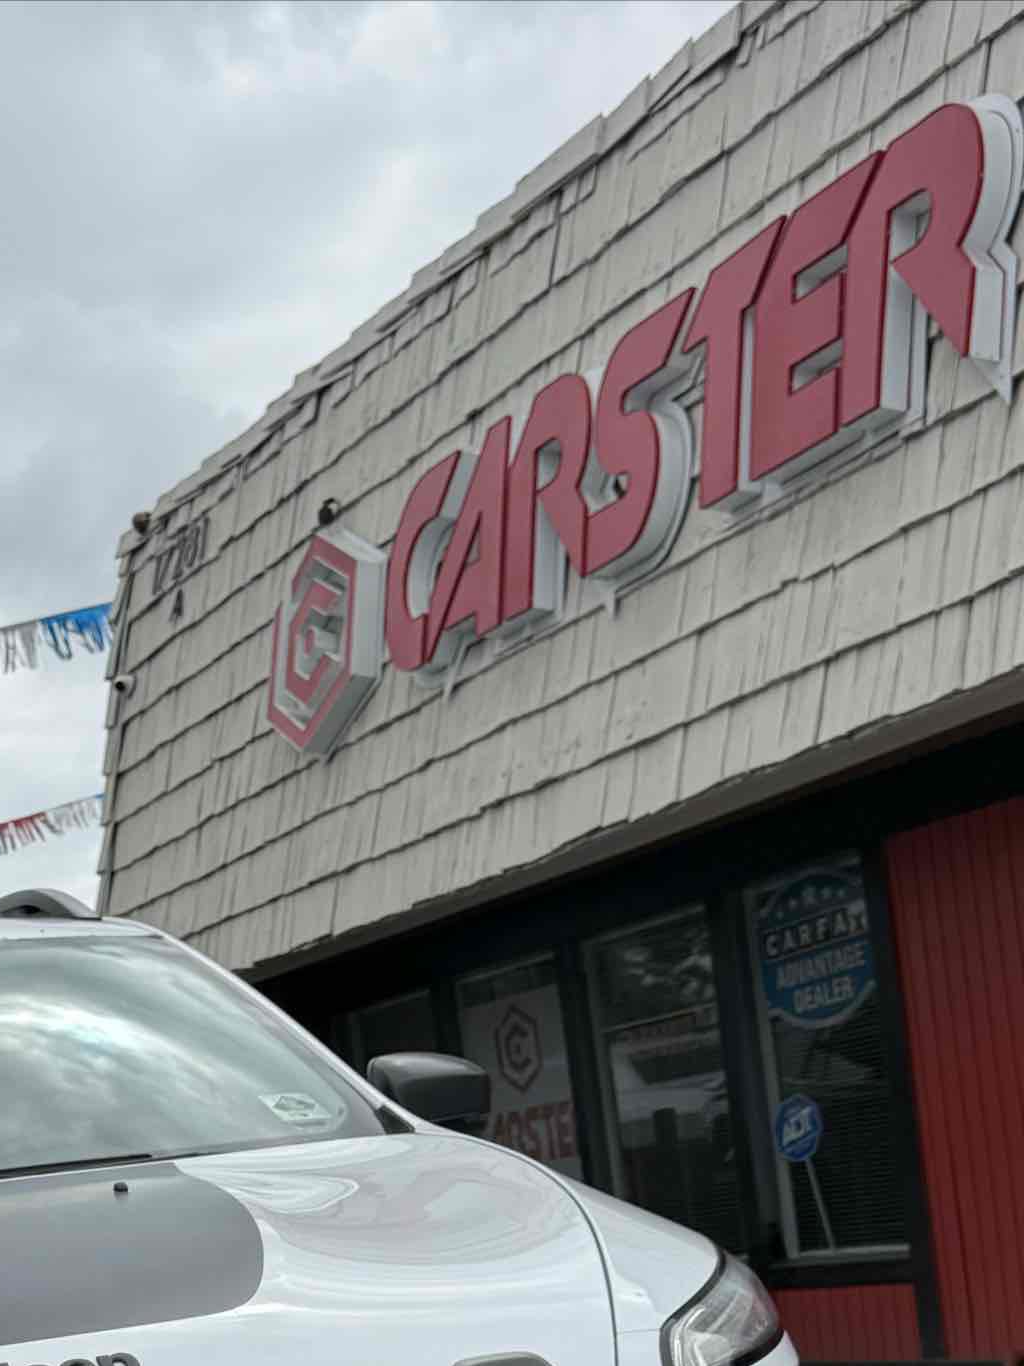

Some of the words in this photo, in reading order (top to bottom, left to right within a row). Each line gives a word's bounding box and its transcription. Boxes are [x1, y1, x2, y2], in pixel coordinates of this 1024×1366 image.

[385, 101, 986, 672] CARSTER
[765, 907, 868, 957] CARFAX
[776, 942, 866, 990] ADVANTAGE
[794, 975, 855, 1012] DEALER
[783, 1105, 814, 1146] ADT
